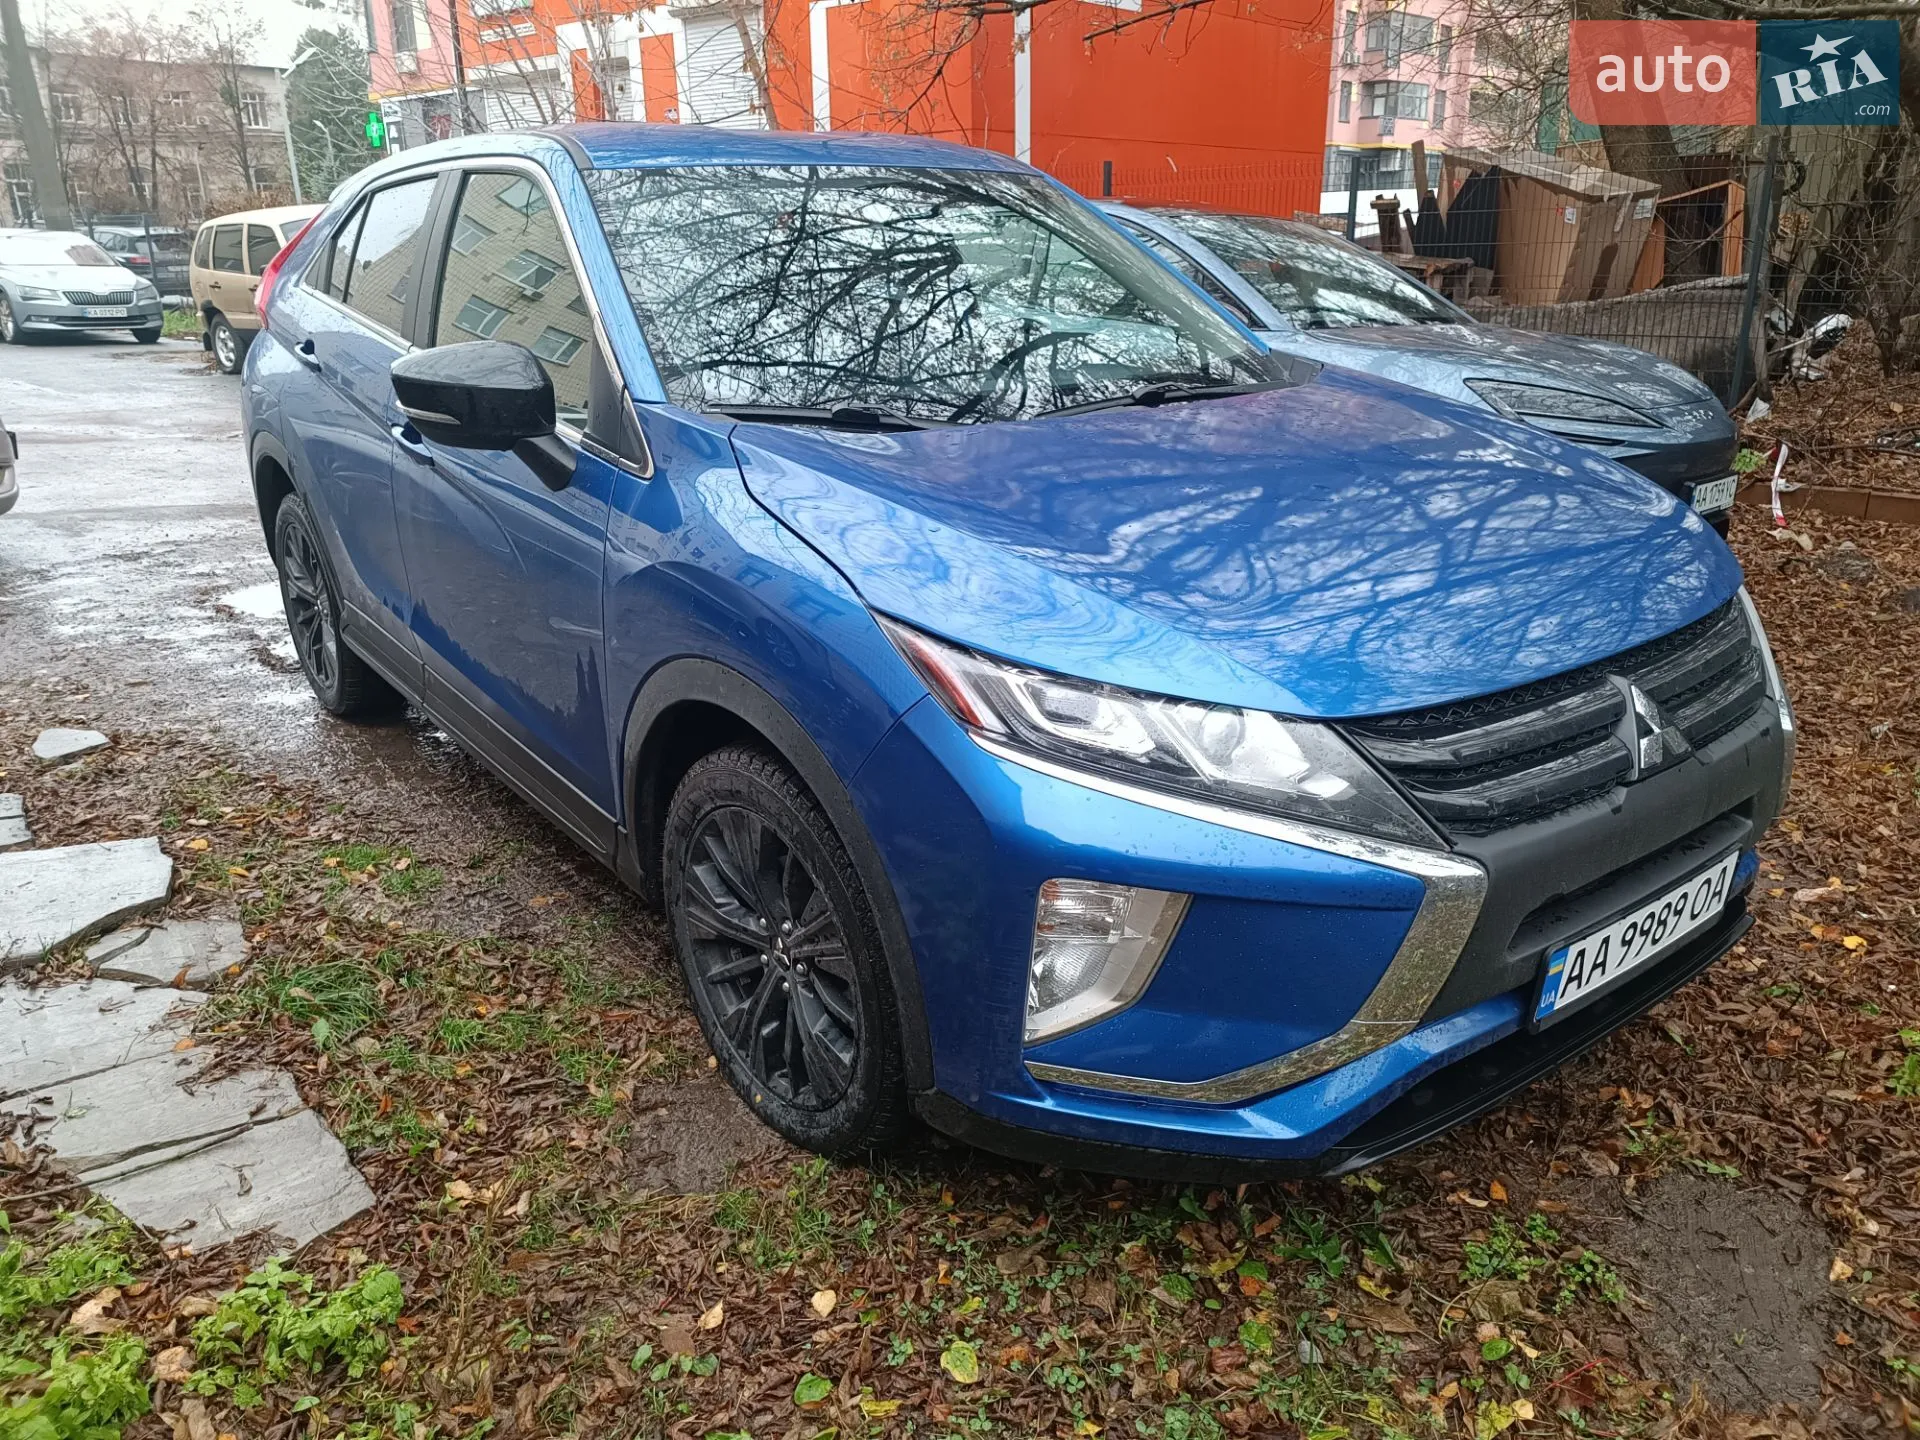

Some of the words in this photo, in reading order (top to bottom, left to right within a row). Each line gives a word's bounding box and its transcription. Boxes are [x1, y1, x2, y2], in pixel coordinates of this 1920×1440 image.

[1696, 486, 1708, 507] AA
[1559, 946, 1611, 999] AA
[1614, 891, 1689, 969] 9989
[1690, 864, 1728, 921] OA
[1540, 989, 1556, 1008] UA
